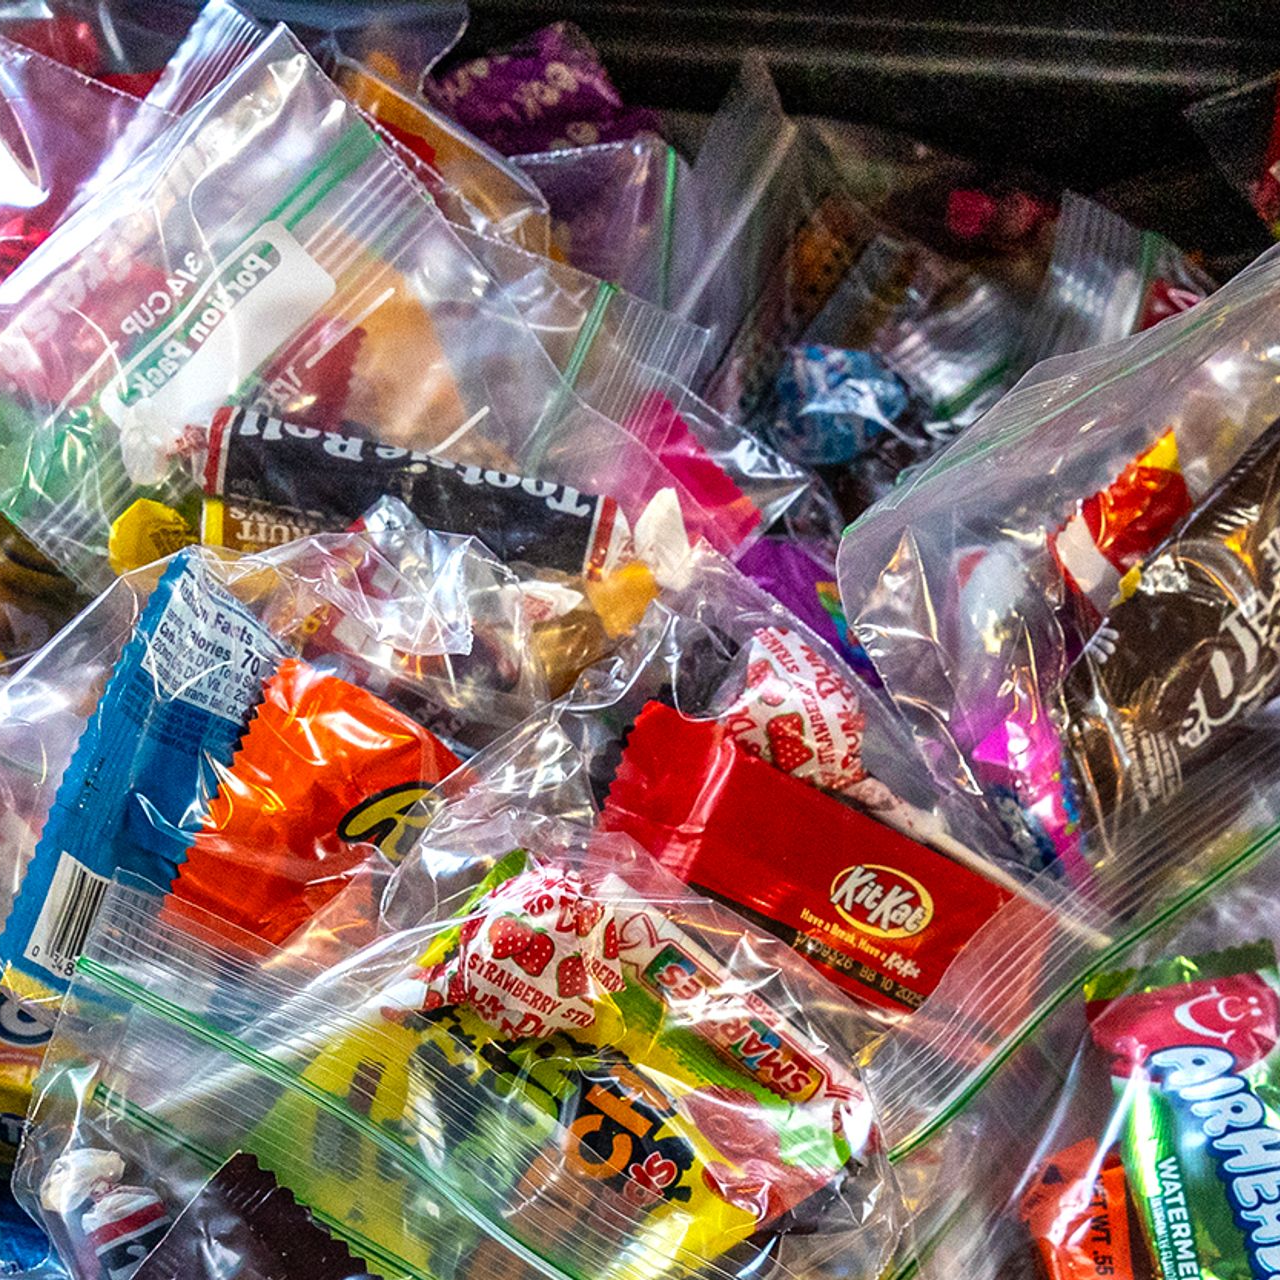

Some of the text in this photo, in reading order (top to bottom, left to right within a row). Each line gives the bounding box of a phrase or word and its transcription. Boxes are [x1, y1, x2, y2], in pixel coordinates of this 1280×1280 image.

[239, 648, 261, 677] 70
[831, 865, 925, 933] KitKat
[801, 907, 825, 928] Have
[858, 938, 881, 958] Have
[467, 953, 563, 1017] STRAWBERRY
[880, 975, 893, 993] 10
[1096, 1215, 1113, 1248] WT
